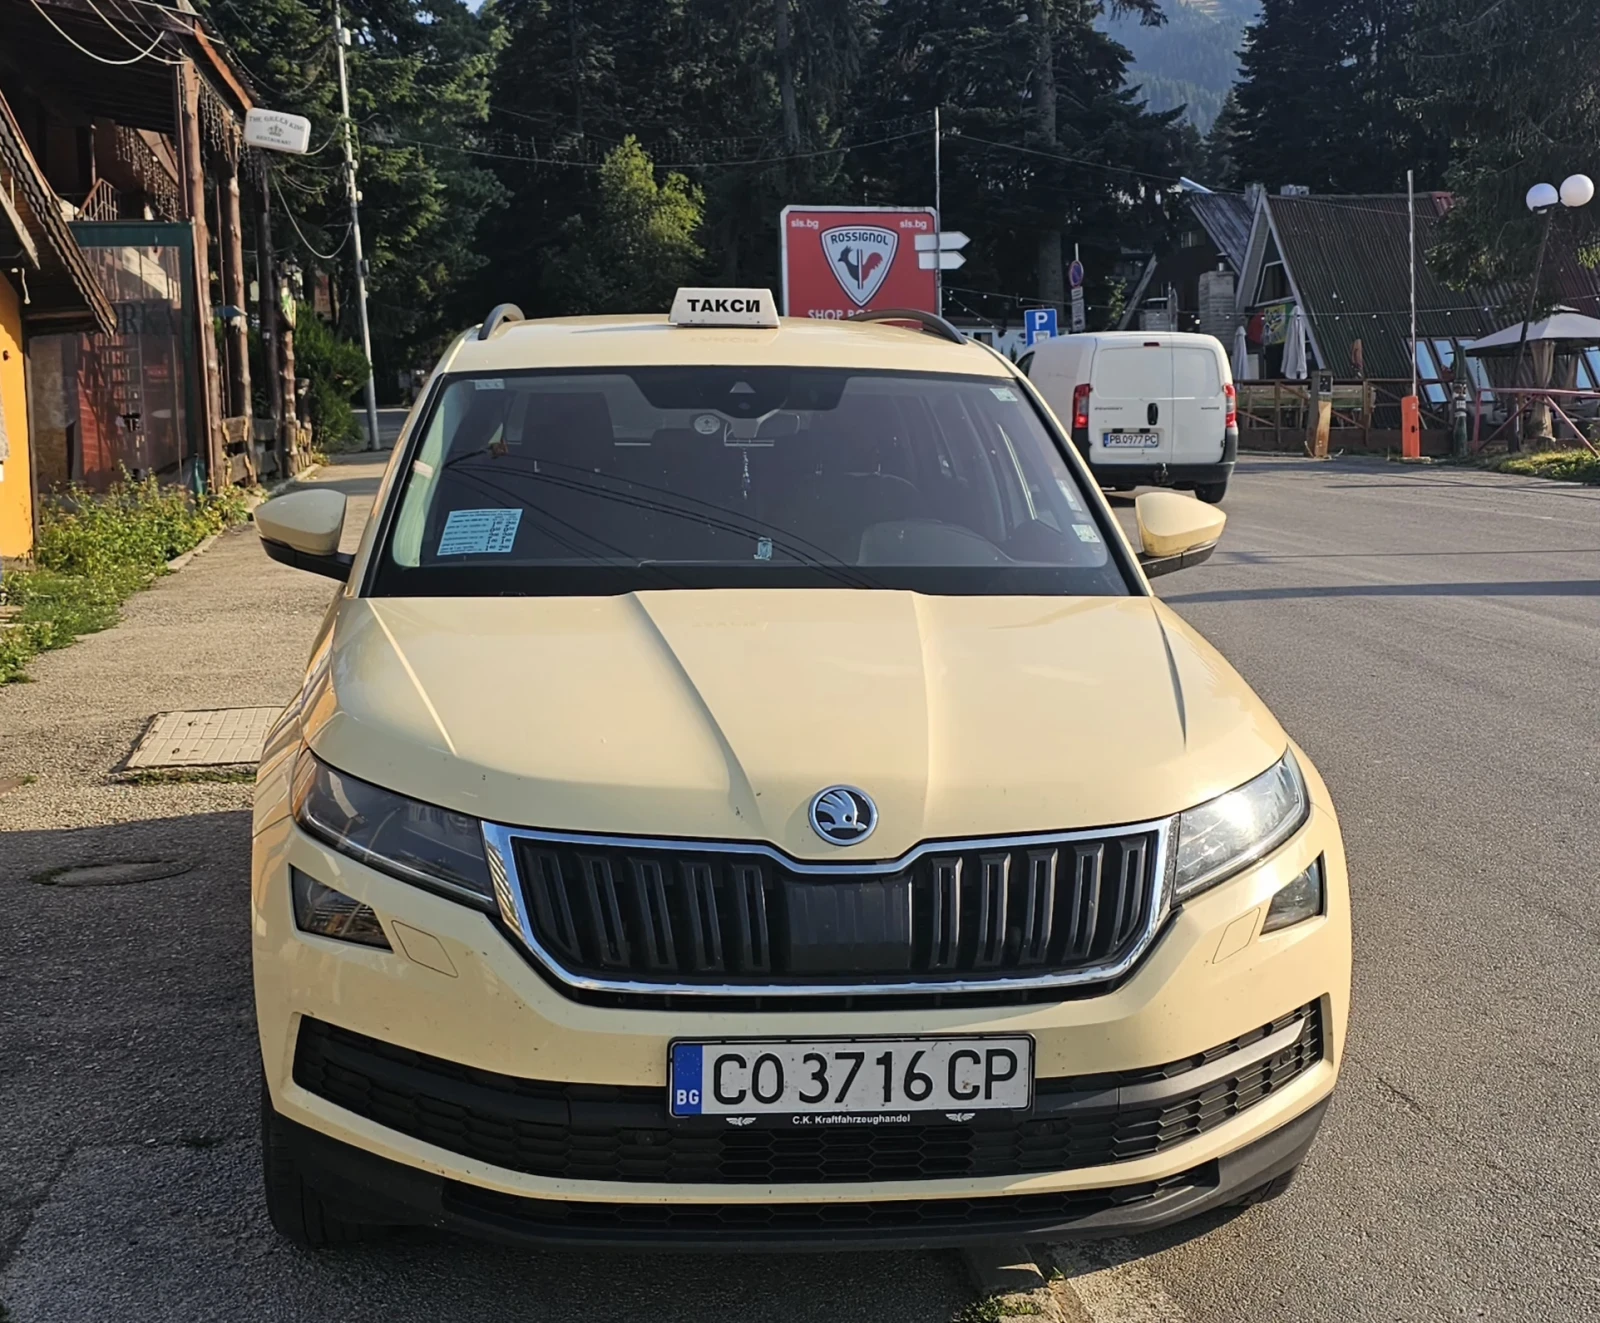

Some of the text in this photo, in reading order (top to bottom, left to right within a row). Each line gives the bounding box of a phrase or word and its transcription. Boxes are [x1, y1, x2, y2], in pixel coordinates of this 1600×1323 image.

[264, 116, 288, 125] GREEN
[791, 219, 819, 230] sls.bg
[900, 220, 927, 231] sls.bg
[830, 231, 889, 246] ROSSIGNOL
[687, 299, 760, 313] ТАКСИ
[808, 309, 844, 320] SHOP
[1035, 312, 1048, 330] P
[799, 1050, 933, 1104] 3716
[948, 1048, 1018, 1101] CP
[676, 1089, 700, 1105] BG
[792, 1113, 911, 1126] C.K. Kraftfahrzeughandel
